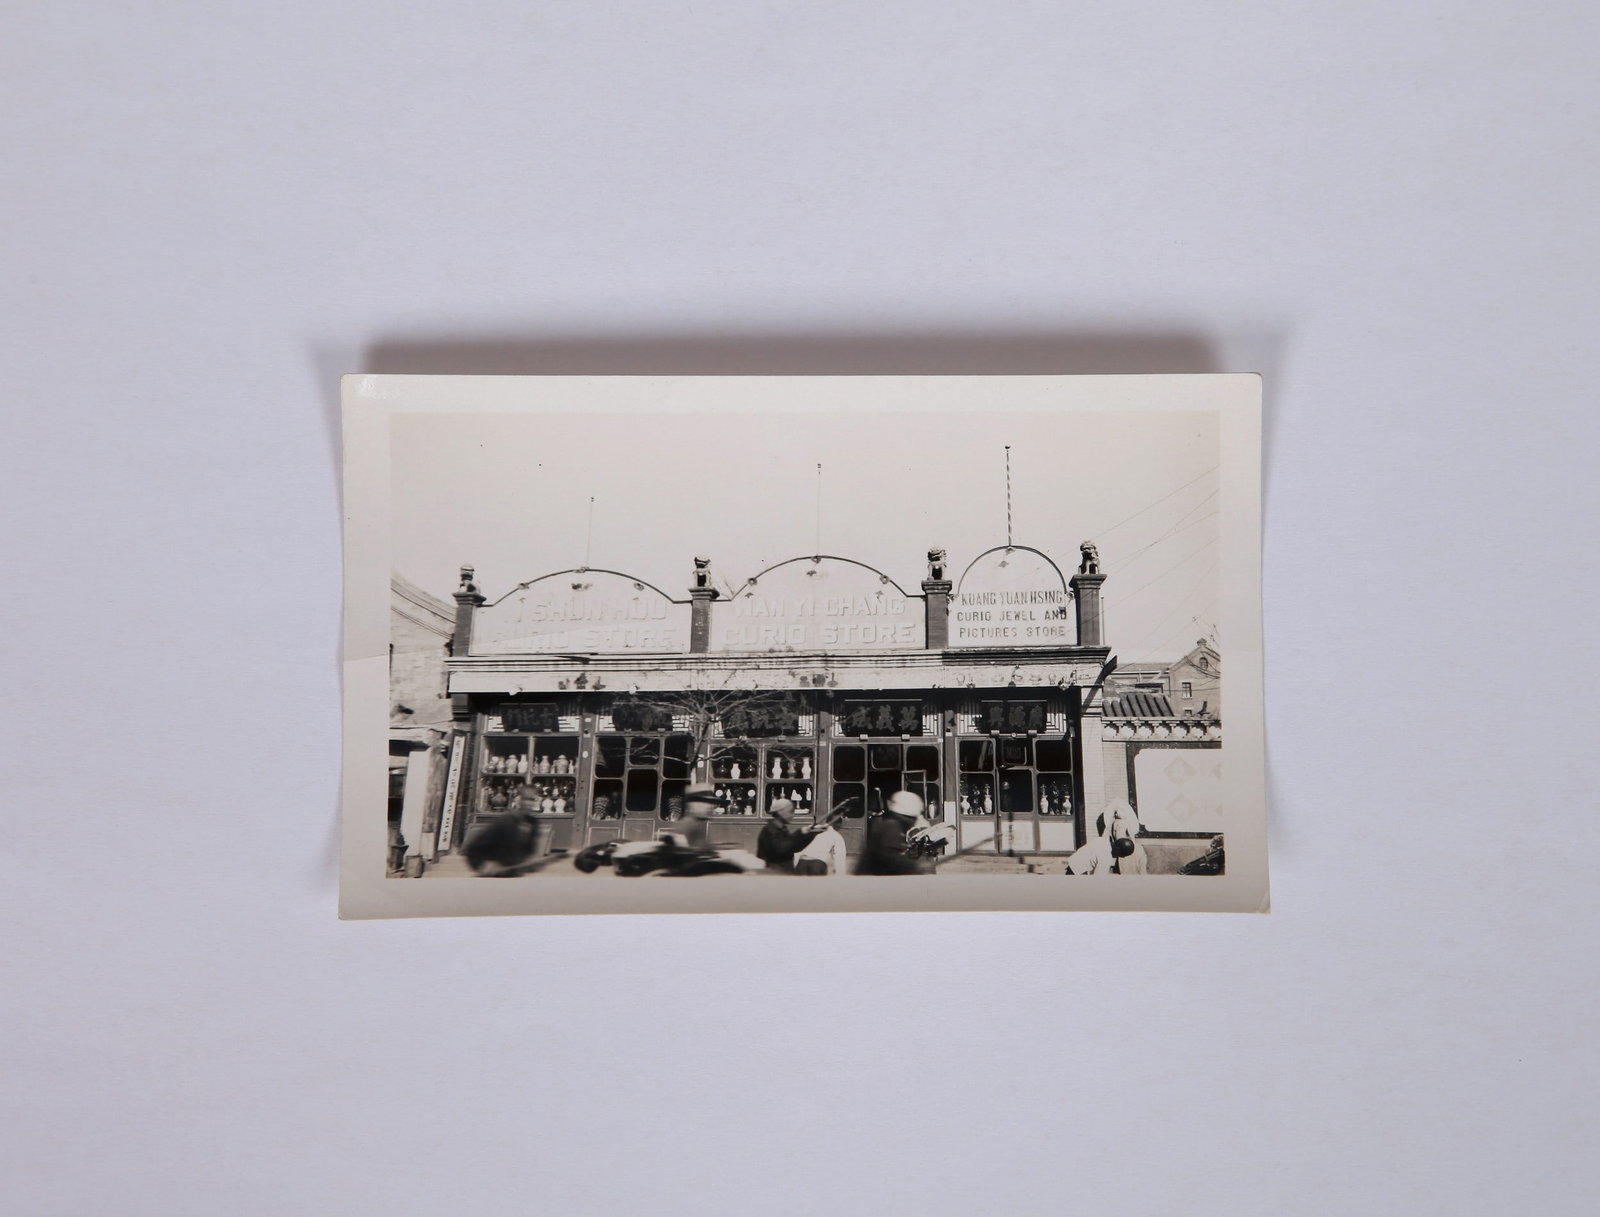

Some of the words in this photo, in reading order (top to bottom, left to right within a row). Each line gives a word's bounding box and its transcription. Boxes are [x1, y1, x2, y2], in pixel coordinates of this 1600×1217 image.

[960, 591, 997, 606] KUANG
[999, 591, 1029, 606] YUAN
[1029, 590, 1064, 606] HSING
[826, 596, 907, 617] CHANG
[956, 611, 993, 622] CURIO
[999, 610, 1037, 622] JEWEL
[1043, 609, 1067, 621] AND
[722, 626, 808, 647] CURIO
[822, 624, 918, 646] STORE
[958, 626, 1018, 639] PICTURES
[1025, 625, 1066, 638] STORE
